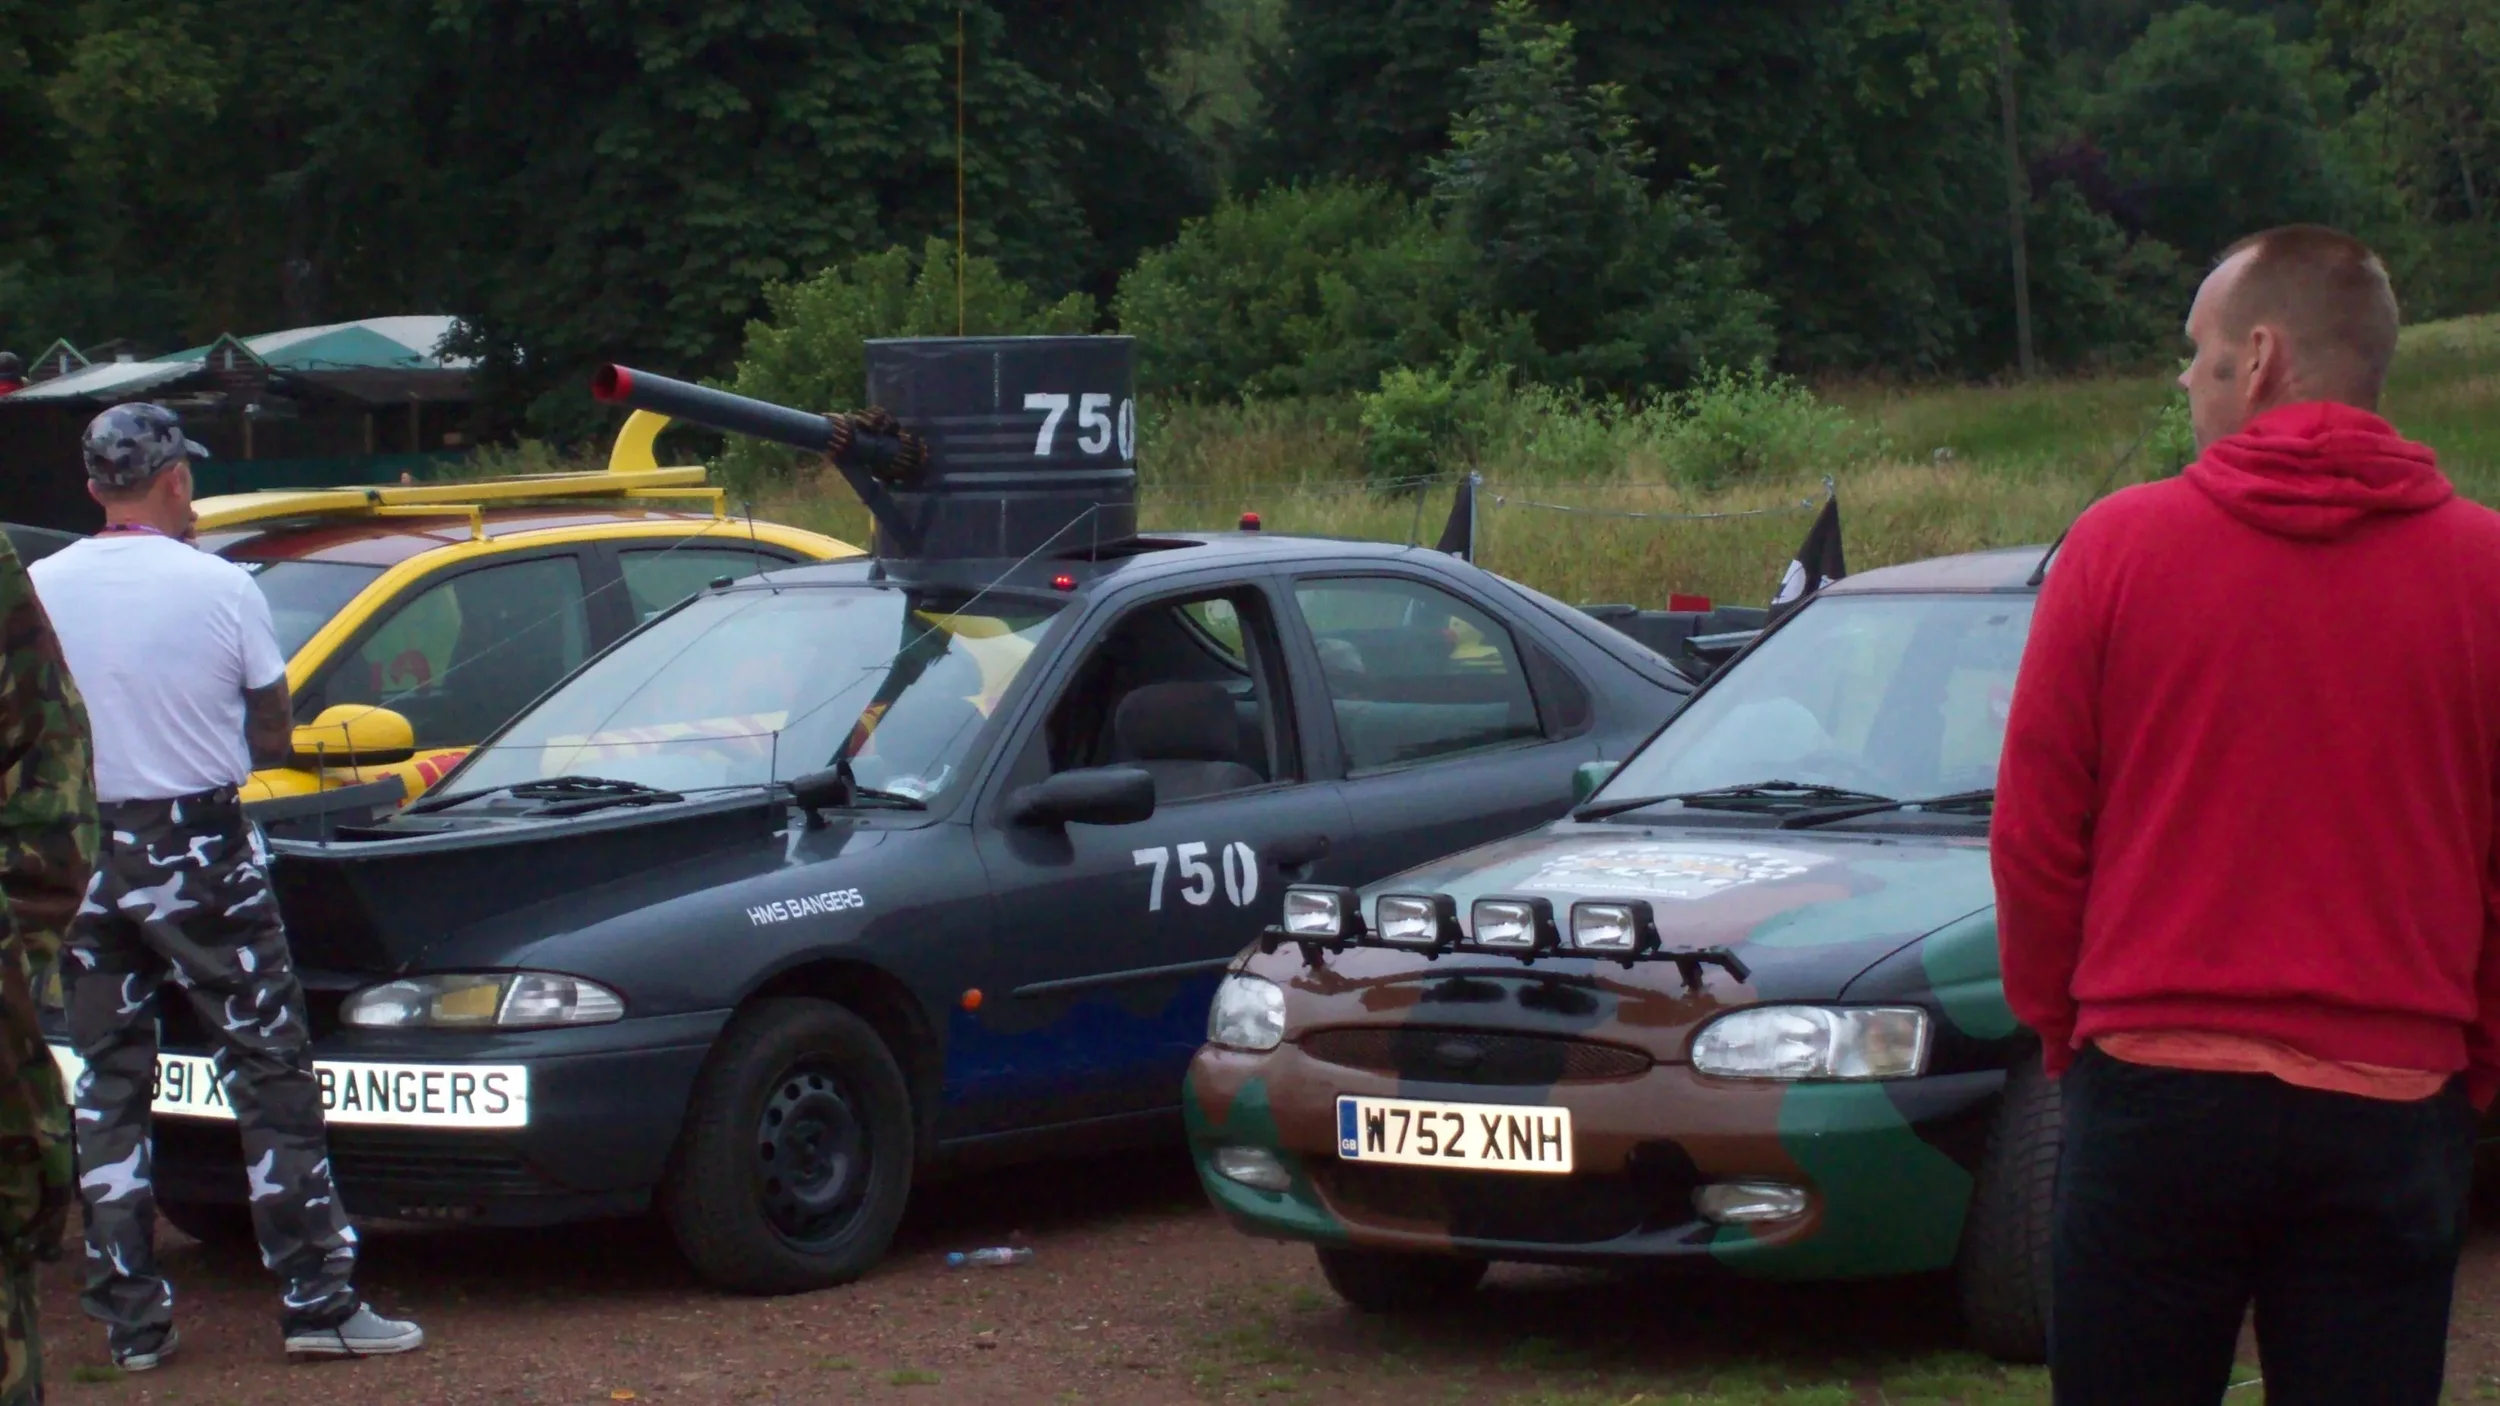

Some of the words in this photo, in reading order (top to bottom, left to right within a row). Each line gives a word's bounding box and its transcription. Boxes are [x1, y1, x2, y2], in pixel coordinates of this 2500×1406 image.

[1023, 392, 1136, 461] 750
[1131, 841, 1259, 912] 750
[746, 901, 789, 926] HMS
[785, 887, 865, 918] BANGERS
[315, 1068, 510, 1115] BANGERS
[1341, 1138, 1357, 1150] GB
[1364, 1106, 1466, 1158] W752
[1479, 1112, 1563, 1162] XNH
